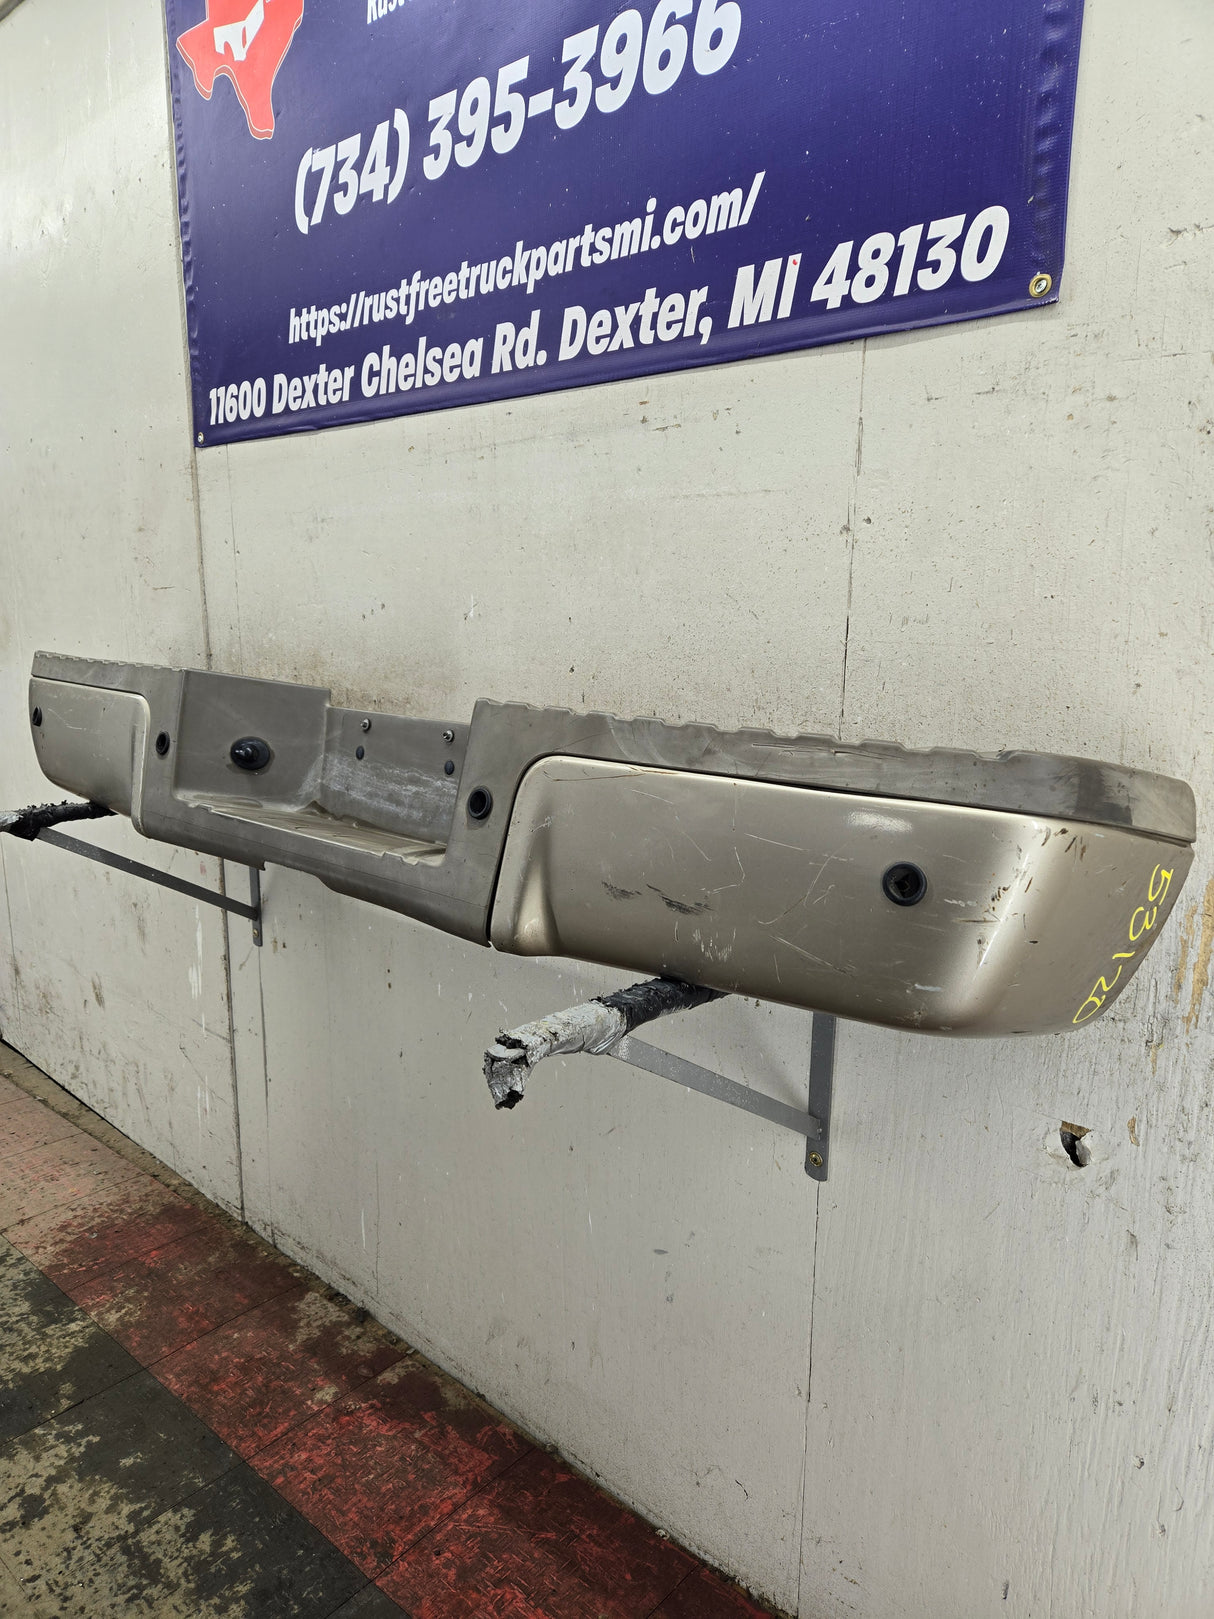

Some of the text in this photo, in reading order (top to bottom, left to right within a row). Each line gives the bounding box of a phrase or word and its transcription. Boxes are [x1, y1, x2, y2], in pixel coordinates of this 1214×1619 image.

[294, 0, 742, 235] (734) 395-3966
[208, 205, 1010, 426] 11600 Dexter Chelsea Rd. Dexter, MI 48130
[288, 170, 767, 347] https://rustfreetruckpartsmi.com/
